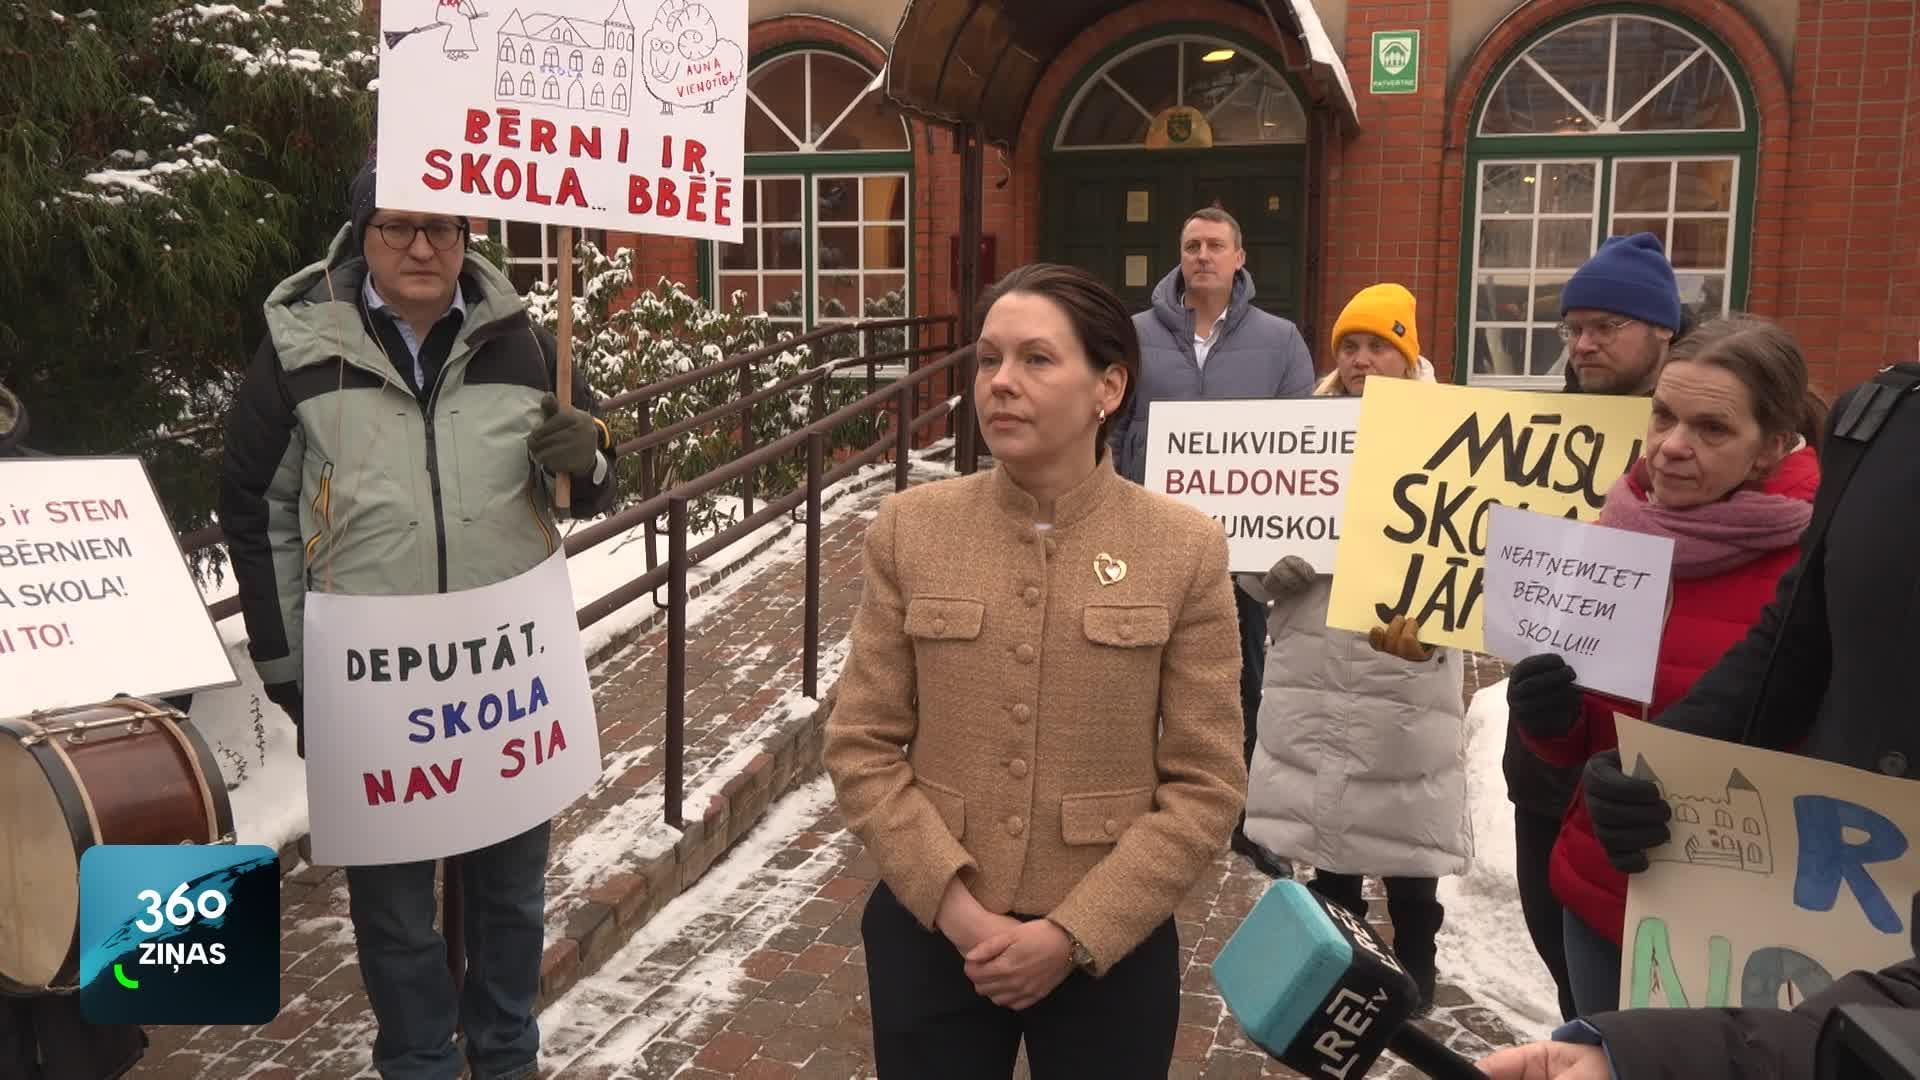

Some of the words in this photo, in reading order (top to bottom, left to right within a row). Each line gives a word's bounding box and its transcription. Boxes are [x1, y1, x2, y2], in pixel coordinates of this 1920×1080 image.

[676, 71, 735, 97] VIENOTĪBA
[687, 58, 721, 76] AUNA
[464, 107, 629, 164] BĒRNI
[661, 135, 716, 178] IR,
[628, 174, 732, 226] BBĒĒ
[1167, 425, 1357, 454] NELIKVIDĒJIE
[1422, 411, 1642, 508] MŪSU
[1165, 469, 1340, 496] BALDONES
[10, 504, 30, 526] ir
[45, 499, 129, 524] STEM
[1212, 514, 1341, 541] UMSKOL
[0, 537, 133, 567] BĒRNIEM
[1500, 545, 1652, 590] NEATŅEMIET
[19, 575, 129, 606] SKOLA!
[1513, 580, 1617, 620] BĒRNIEM
[17, 623, 74, 649] TO!
[346, 621, 545, 682] DEPUTĀT,
[1517, 619, 1600, 656] SKOLU!!!
[408, 675, 549, 743] SKOLA
[363, 758, 463, 806] NAV
[500, 719, 567, 778] SIA
